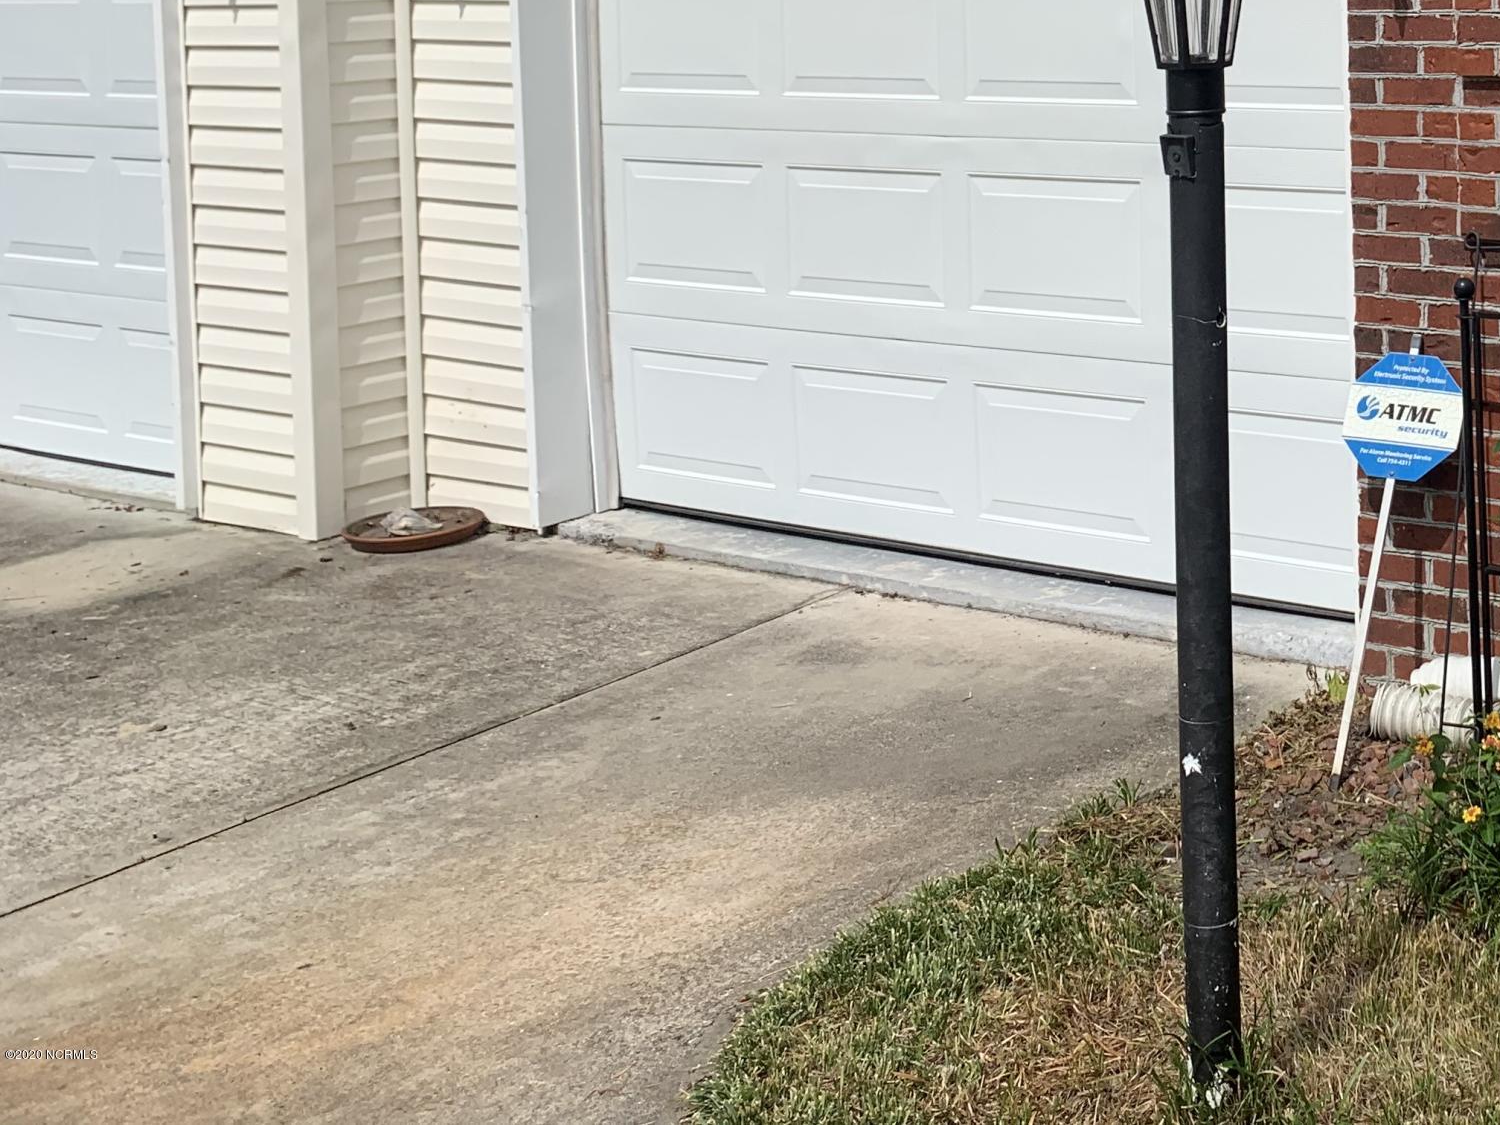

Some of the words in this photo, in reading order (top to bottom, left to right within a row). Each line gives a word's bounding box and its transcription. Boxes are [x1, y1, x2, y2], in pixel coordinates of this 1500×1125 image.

[1401, 373, 1425, 383] Security
[1379, 403, 1441, 424] ATMC
[1397, 425, 1448, 439] security
